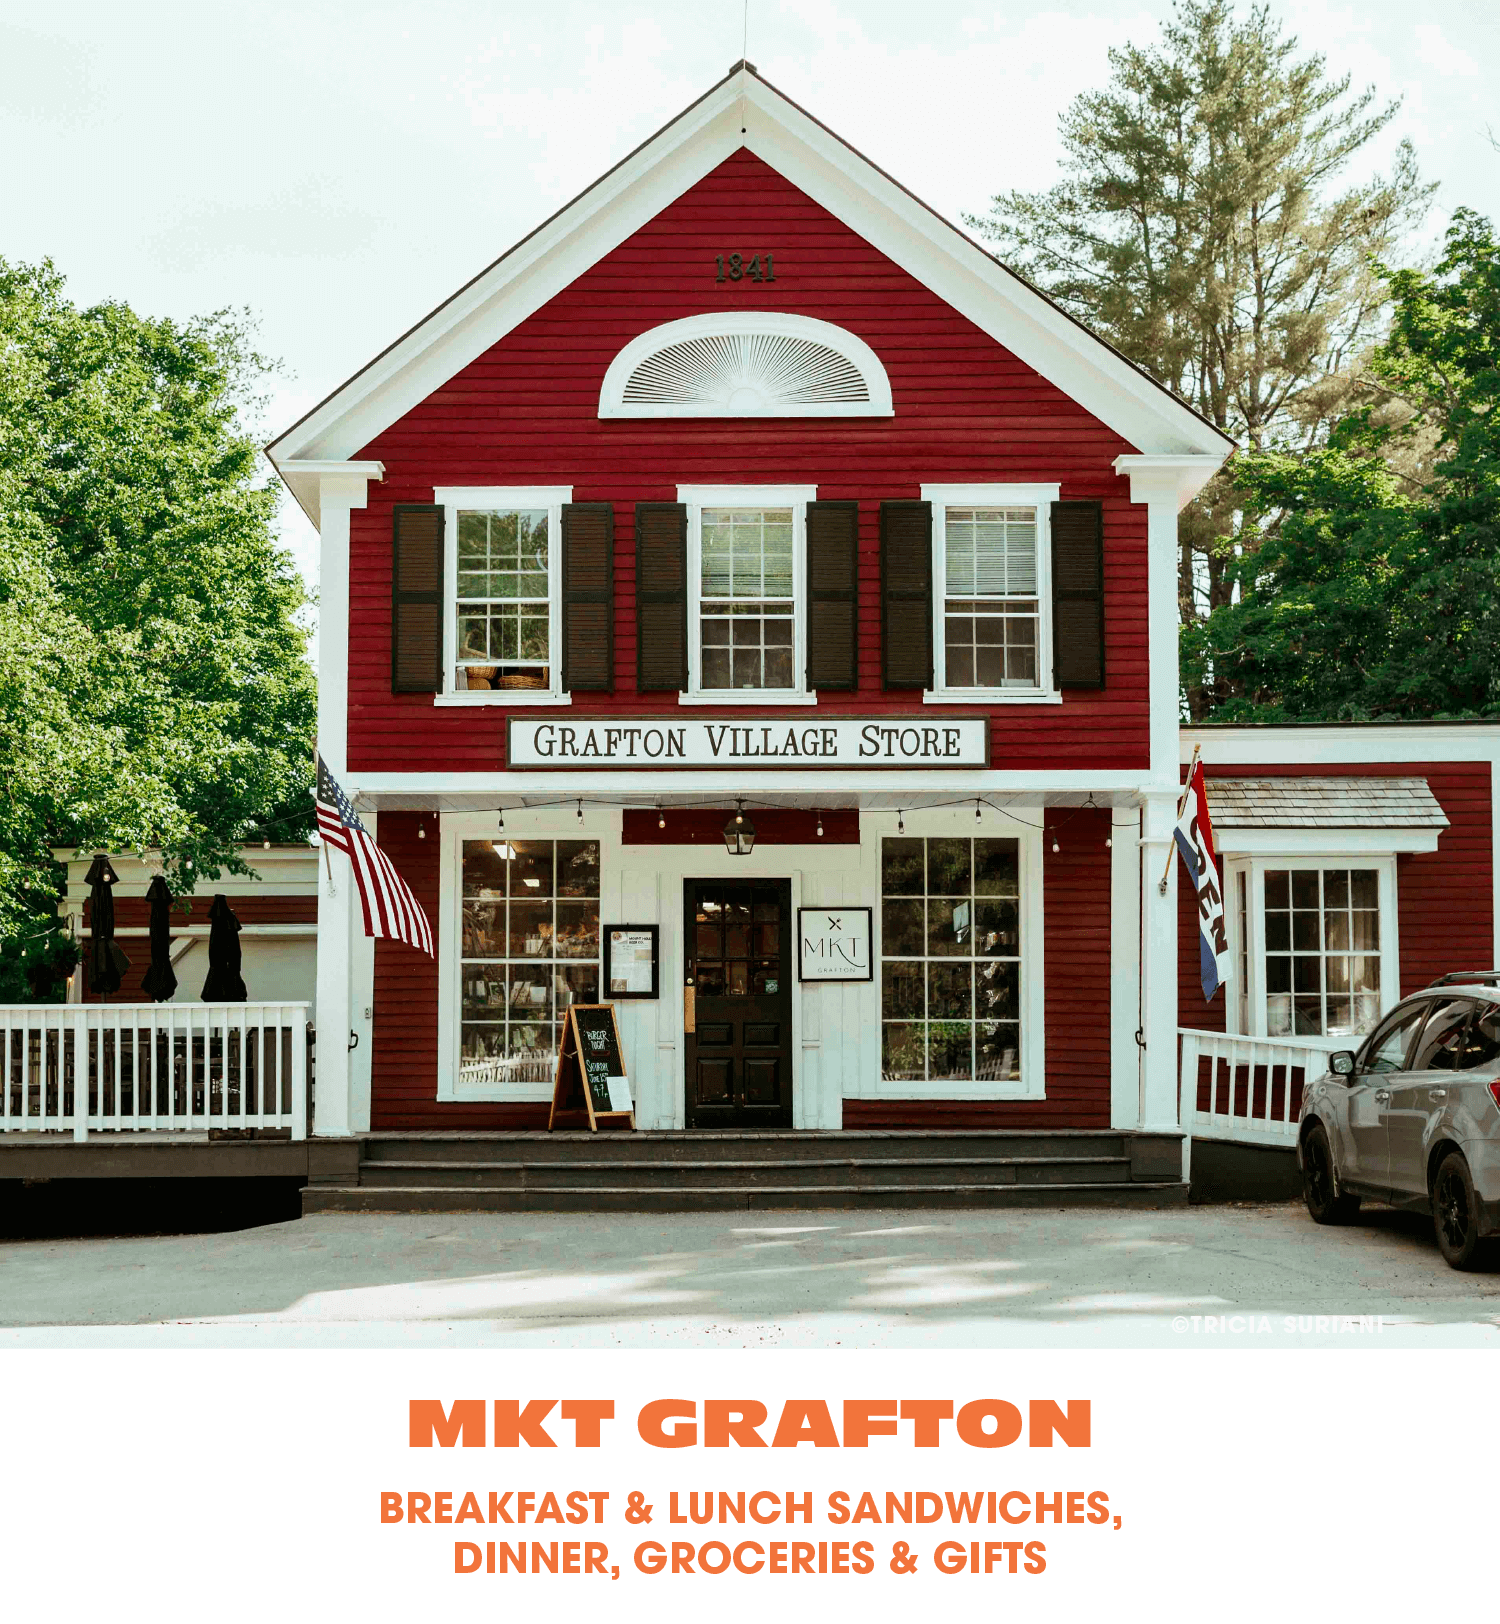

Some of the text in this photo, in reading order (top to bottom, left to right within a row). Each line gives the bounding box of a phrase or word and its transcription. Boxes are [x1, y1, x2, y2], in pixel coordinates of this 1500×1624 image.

[715, 252, 776, 283] 1841
[534, 725, 961, 757] GRAFTON VILLAGE STORE
[804, 937, 866, 968] MKT
[586, 1030, 610, 1042] BURGER
